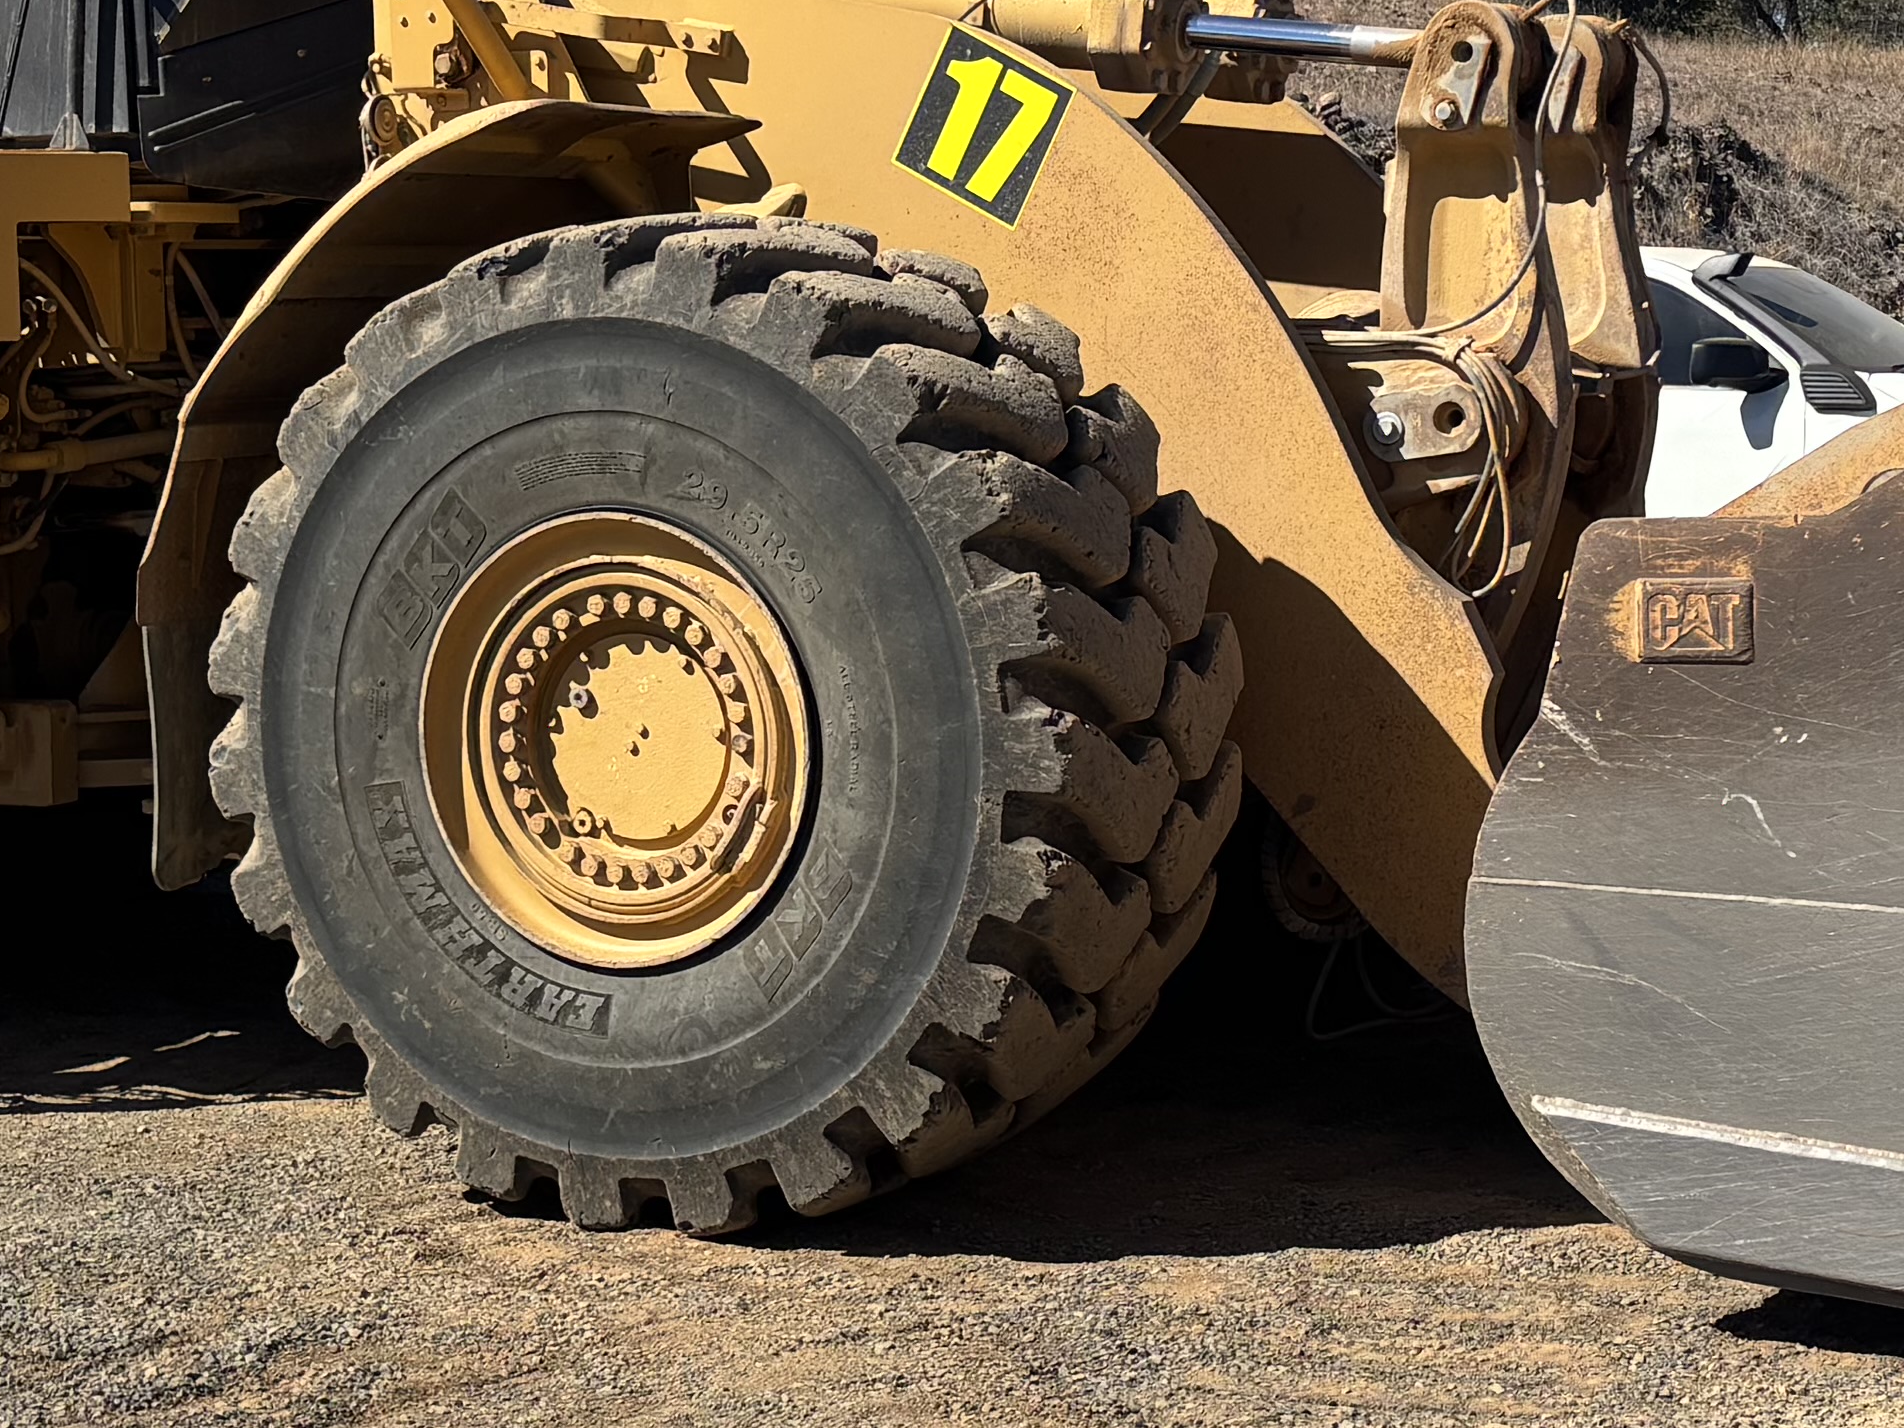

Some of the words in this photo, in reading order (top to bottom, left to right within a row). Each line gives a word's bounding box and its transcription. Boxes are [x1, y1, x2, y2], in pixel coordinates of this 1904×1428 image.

[927, 56, 1059, 203] 17
[377, 485, 487, 651] BKT
[682, 469, 823, 605] 29.5R25
[1648, 593, 1740, 651] CAT
[370, 794, 607, 1032] EARTHMAX
